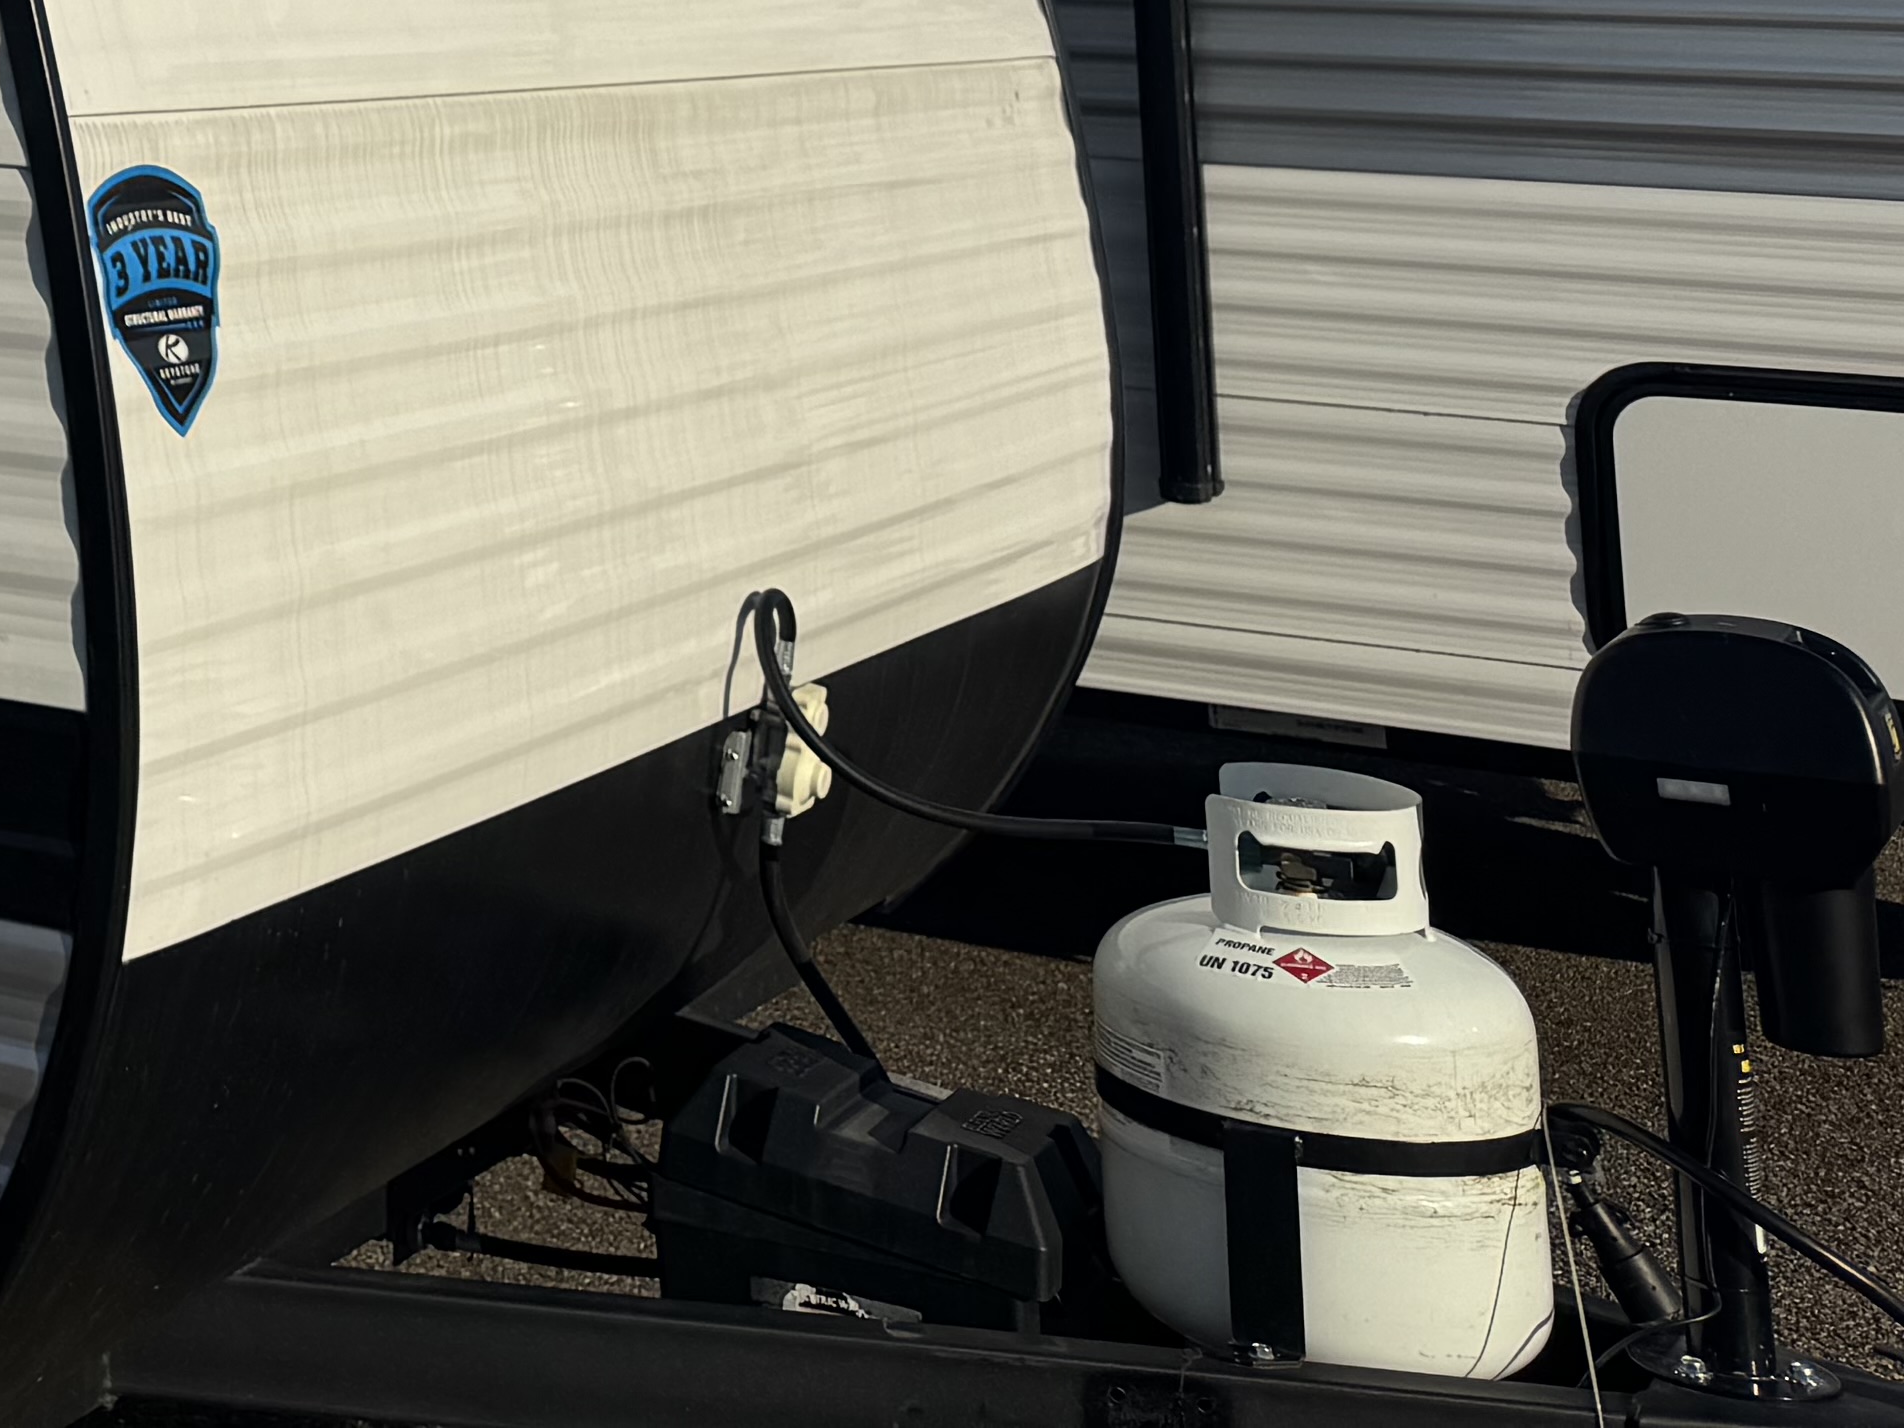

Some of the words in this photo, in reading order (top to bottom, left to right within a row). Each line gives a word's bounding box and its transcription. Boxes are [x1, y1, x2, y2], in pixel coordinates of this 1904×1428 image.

[110, 250, 130, 298] 3
[131, 235, 210, 287] YEAR
[1215, 937, 1276, 956] PROPANE
[1199, 954, 1227, 970] UN
[1230, 959, 1275, 980] 1075
